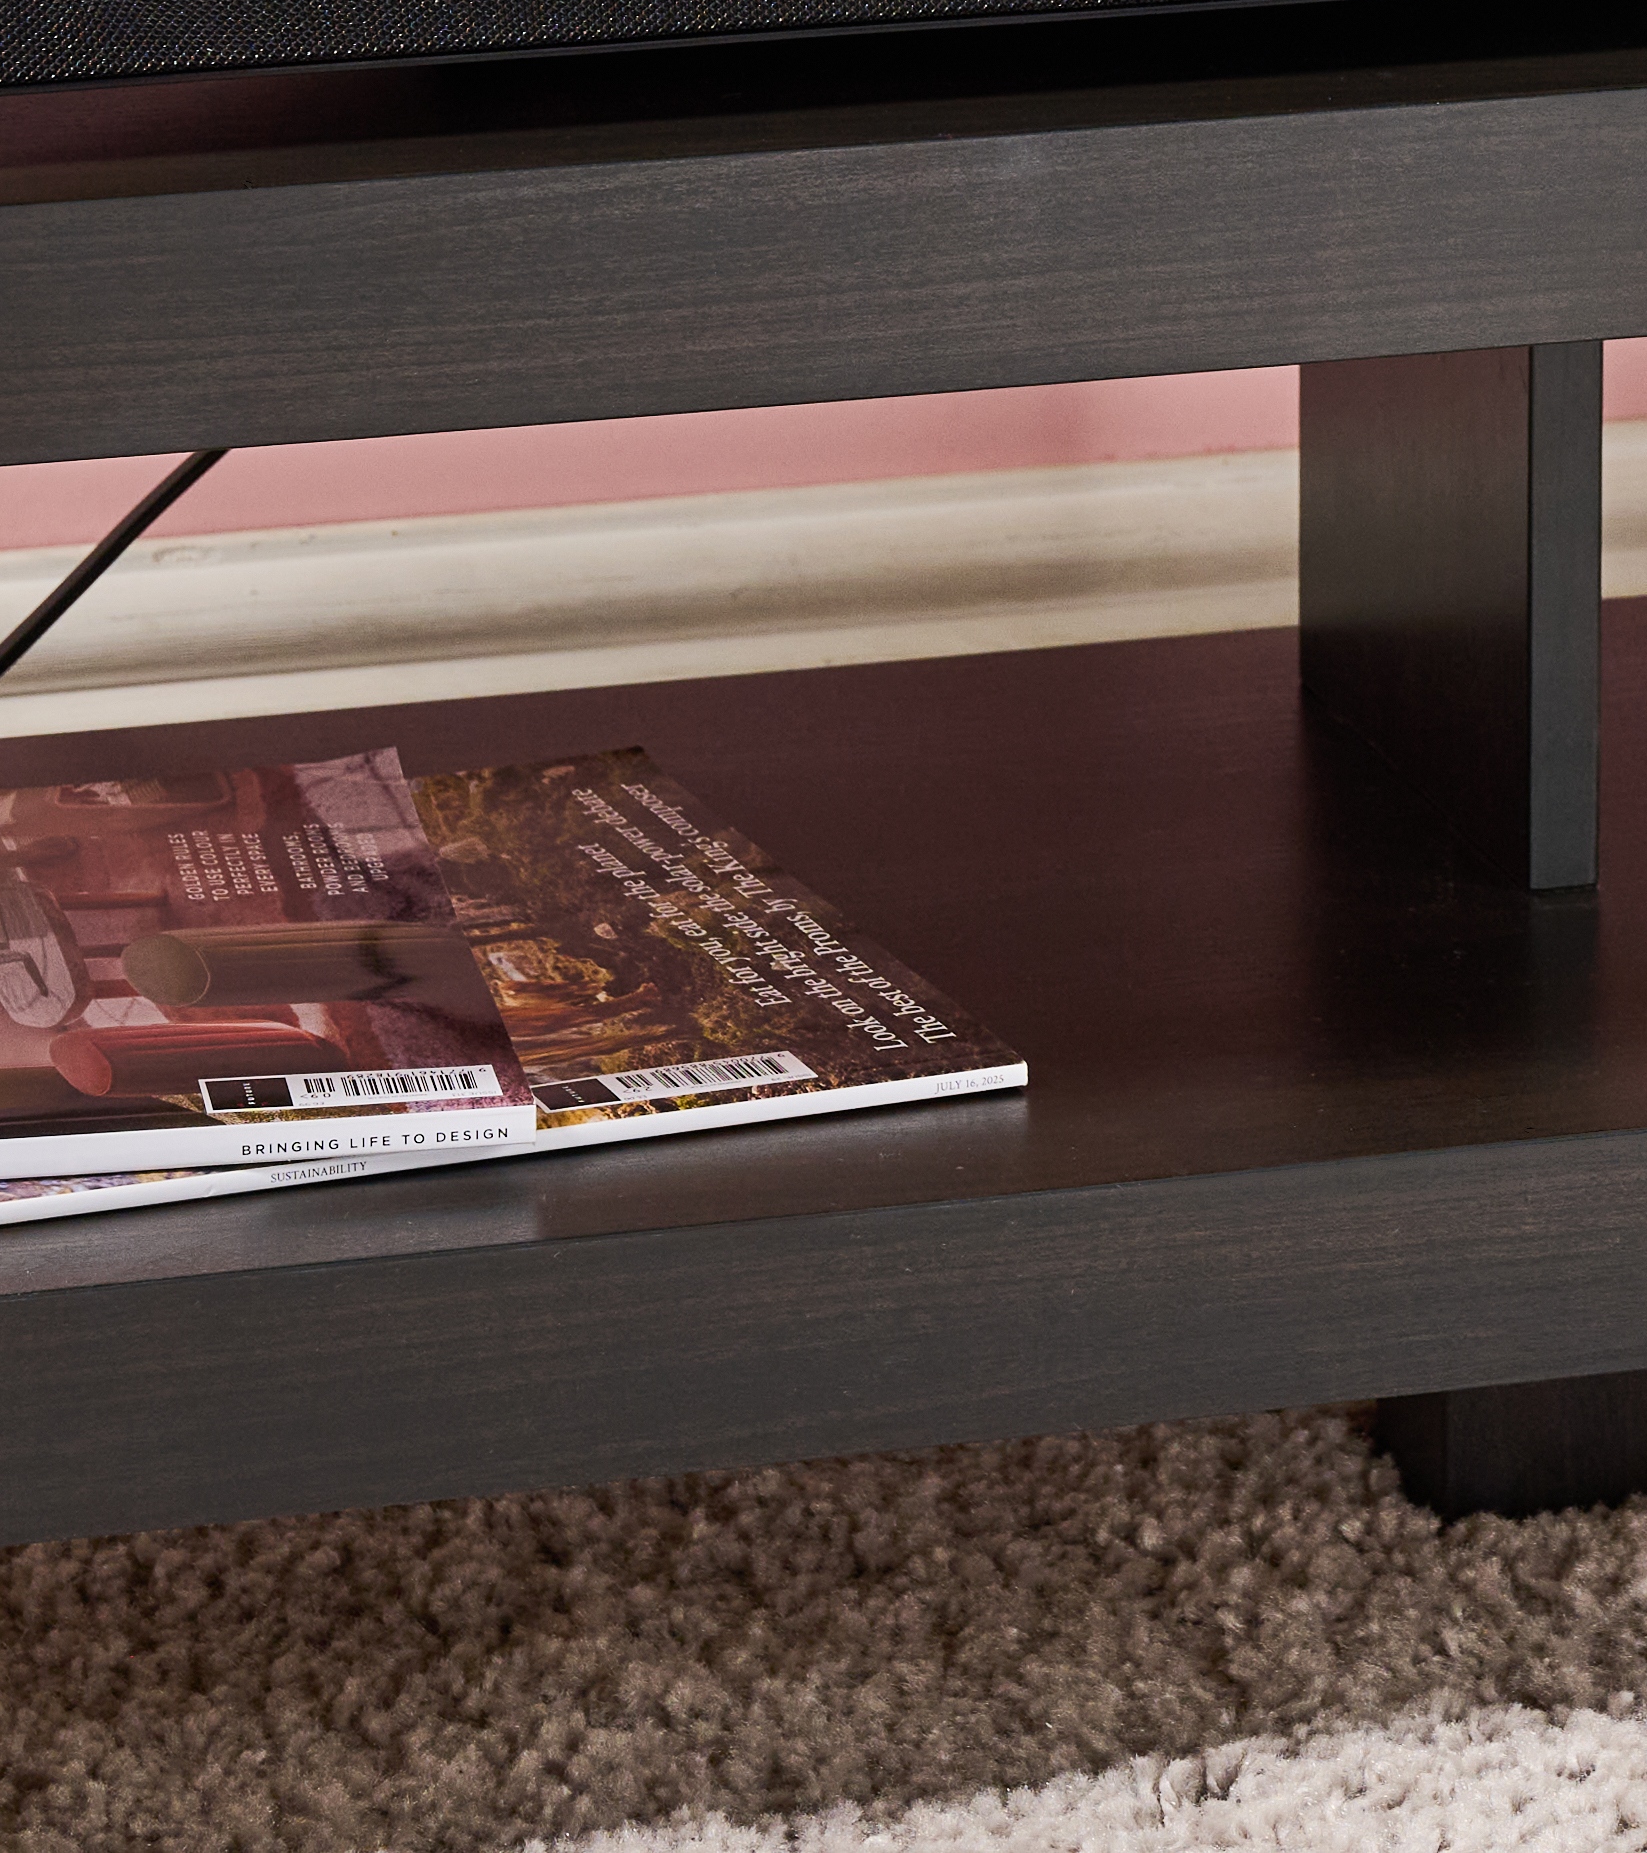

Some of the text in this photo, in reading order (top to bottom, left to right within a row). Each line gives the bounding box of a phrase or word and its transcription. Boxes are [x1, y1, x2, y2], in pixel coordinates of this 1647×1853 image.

[572, 788, 627, 825] debate
[168, 833, 205, 900] GOLDEN RULES
[192, 830, 230, 901] TO USE COLOUR
[223, 845, 253, 895] PERFECTLY
[615, 826, 710, 893] solar-power
[253, 863, 278, 893] EVERY
[621, 784, 957, 1044] The best of the Proms, by The King's composer
[699, 893, 735, 912] the
[578, 843, 792, 1007] Eat for you, eat for the planet
[755, 939, 816, 979] bright
[804, 978, 842, 999] the
[831, 999, 864, 1015] on
[847, 1015, 908, 1051] Look
[934, 1074, 1004, 1095] JULY 16, 2025
[241, 1125, 511, 1157] BRINGING LIFE TO DESIGN
[269, 1160, 368, 1184] SUSTAINABILITY
